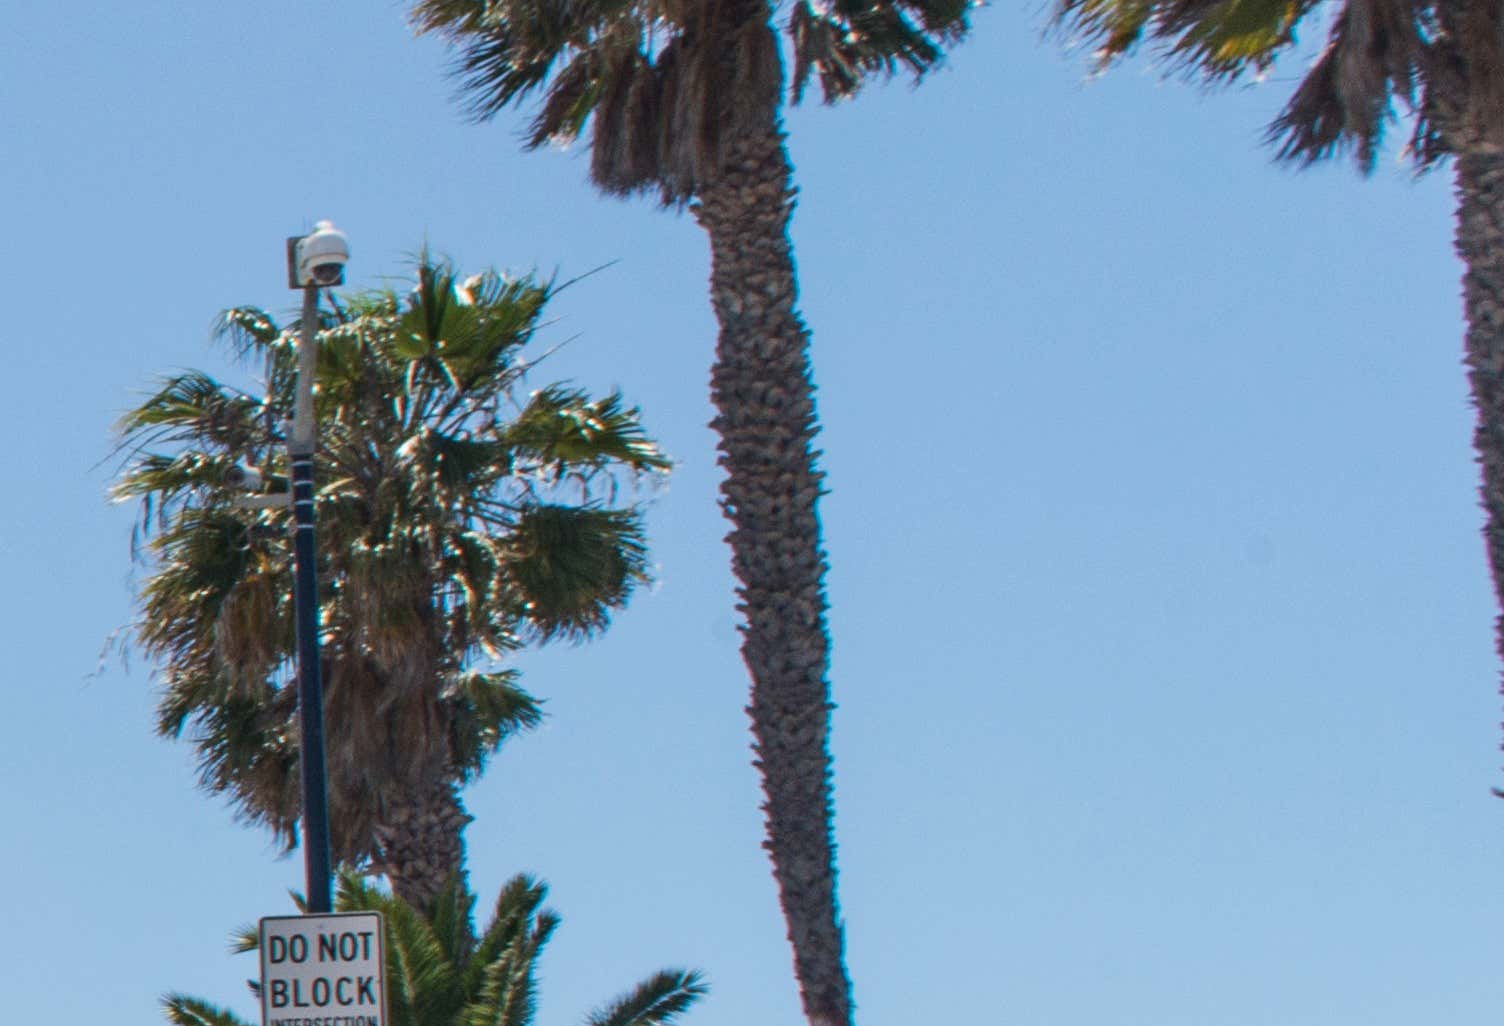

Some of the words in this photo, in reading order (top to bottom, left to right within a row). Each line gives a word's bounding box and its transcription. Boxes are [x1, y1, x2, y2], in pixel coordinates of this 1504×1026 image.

[269, 933, 308, 965] DO
[318, 931, 374, 963] NOT
[270, 975, 377, 1008] BLOCK
